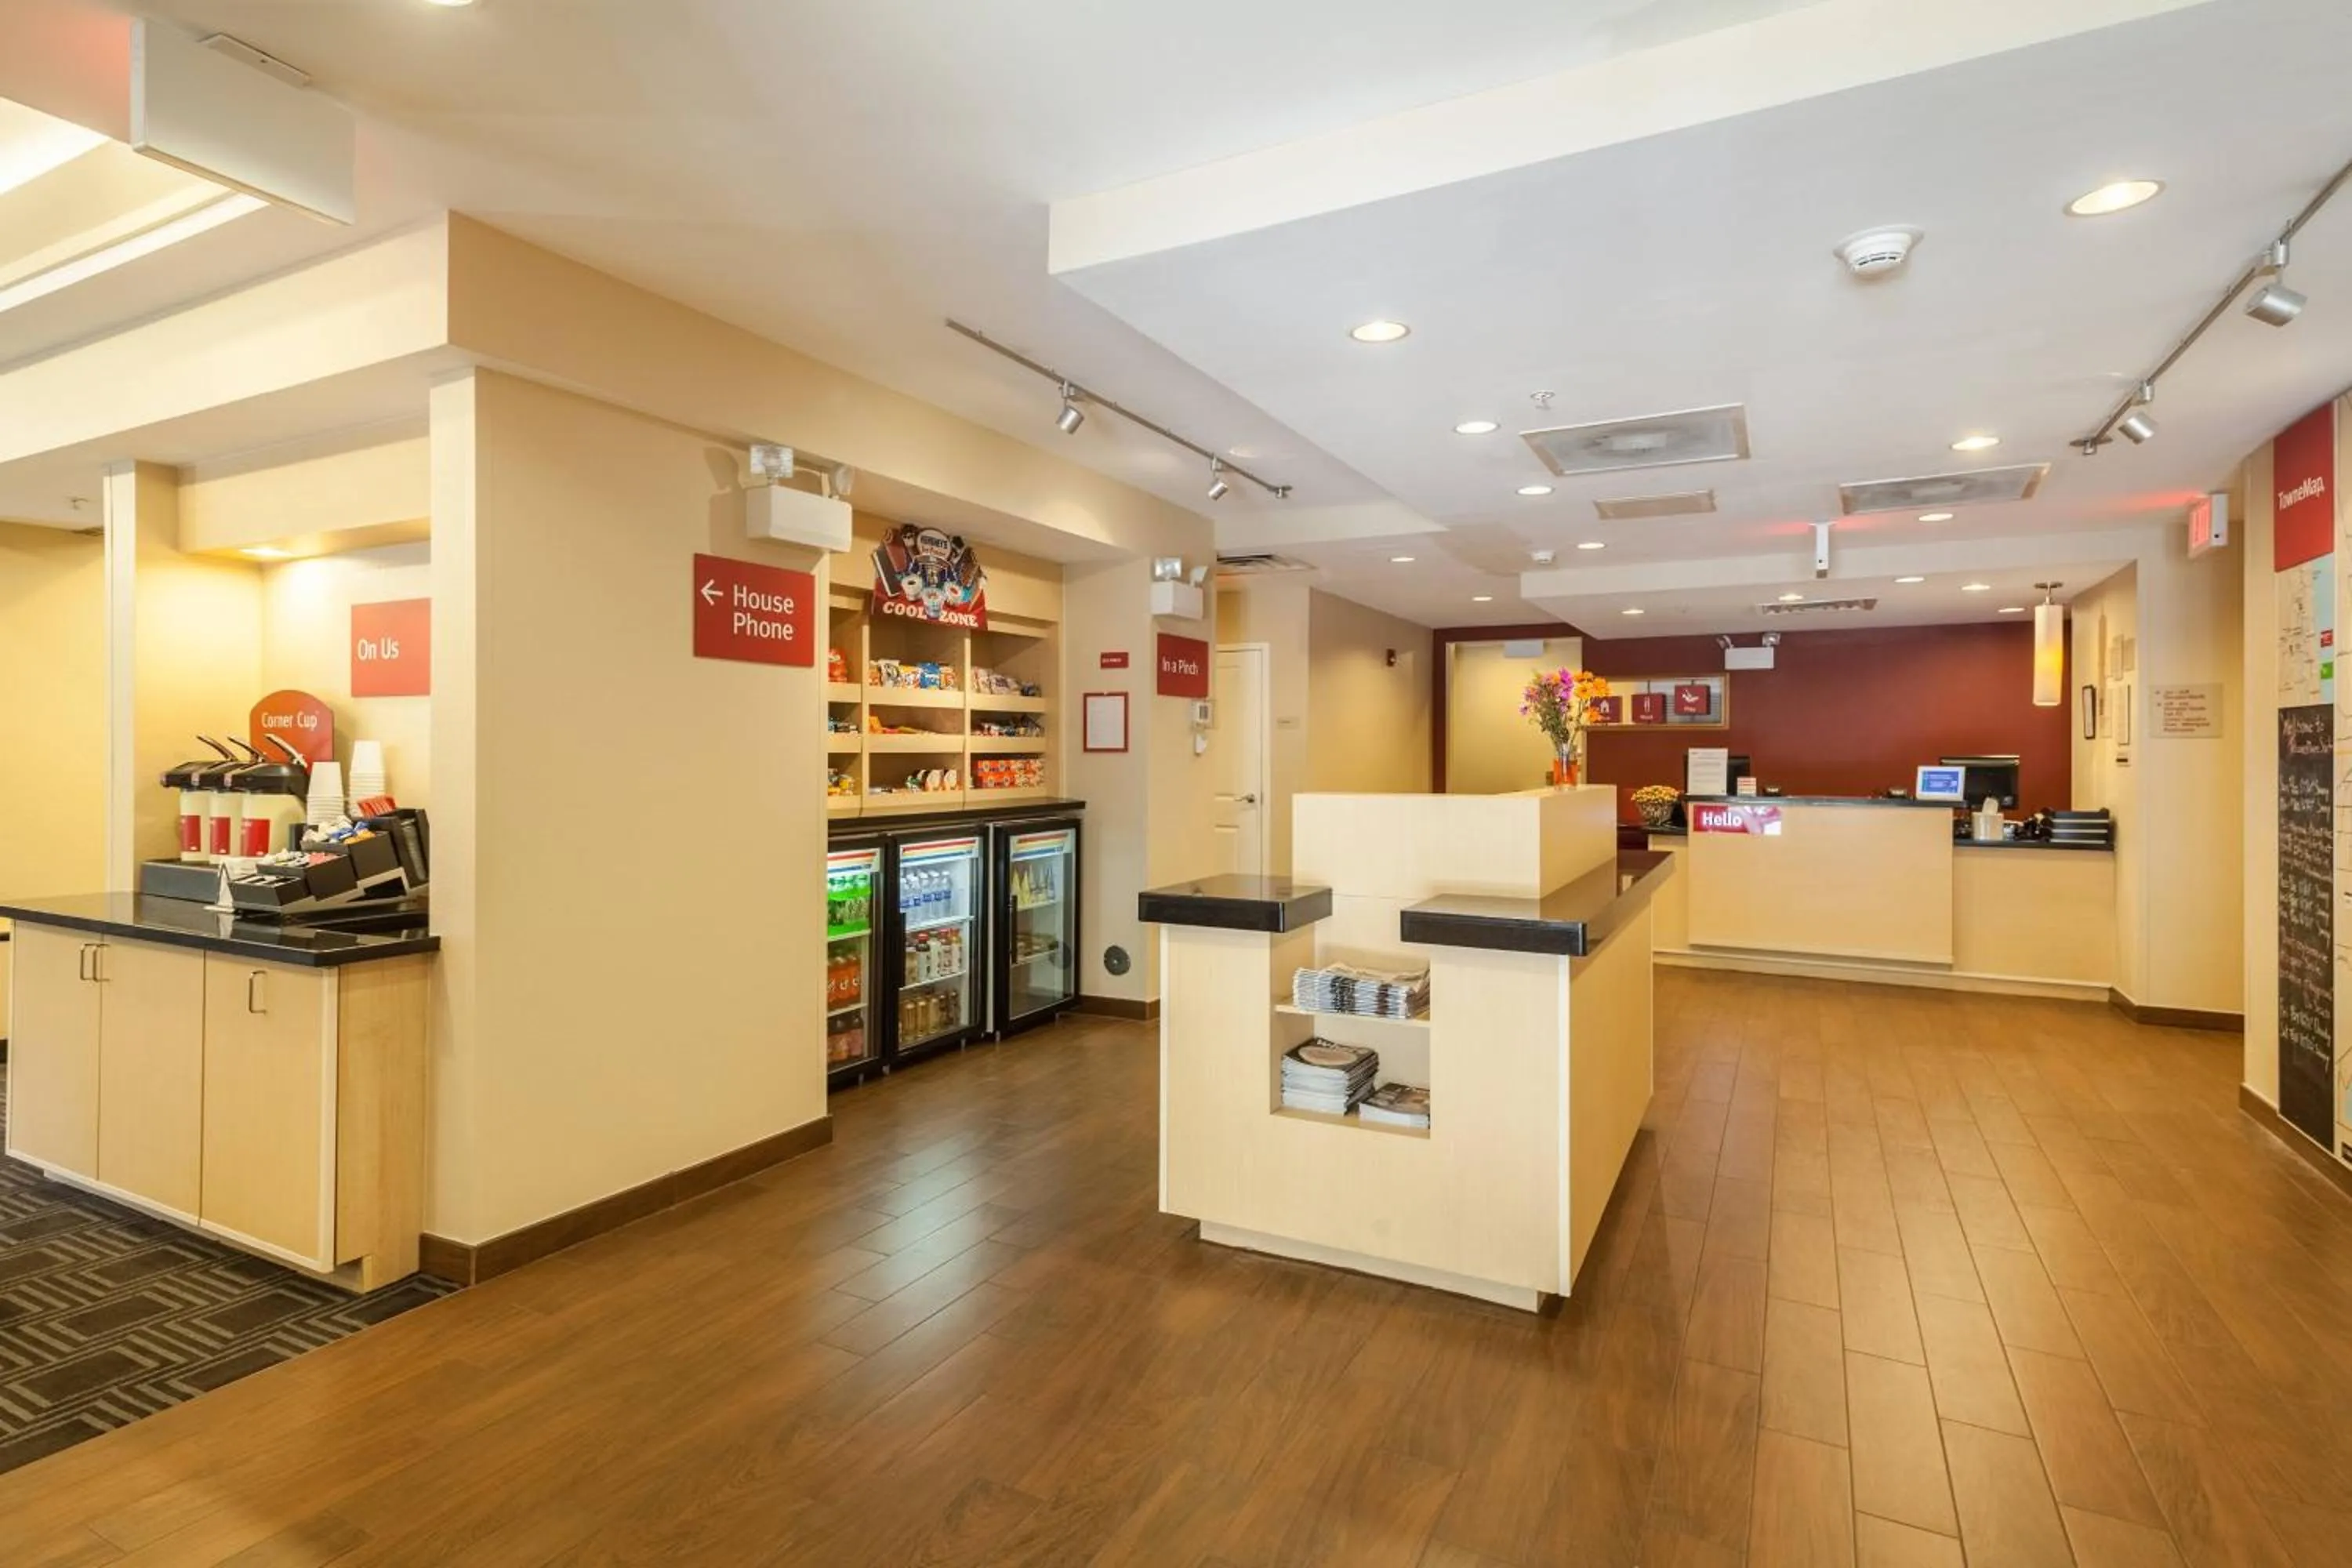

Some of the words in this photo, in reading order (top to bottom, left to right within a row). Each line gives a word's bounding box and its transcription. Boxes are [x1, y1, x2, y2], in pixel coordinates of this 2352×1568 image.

[732, 583, 794, 615] House
[883, 601, 928, 620] COOL
[938, 611, 979, 628] ZONE
[732, 612, 793, 641] Phone
[358, 638, 376, 661] On
[381, 636, 399, 659] Us
[1162, 655, 1171, 672] In
[1171, 661, 1177, 673] a
[1178, 659, 1199, 676] Pinch
[261, 711, 294, 728] Corner
[297, 710, 318, 731] Cup
[1702, 811, 1742, 827] Hello
